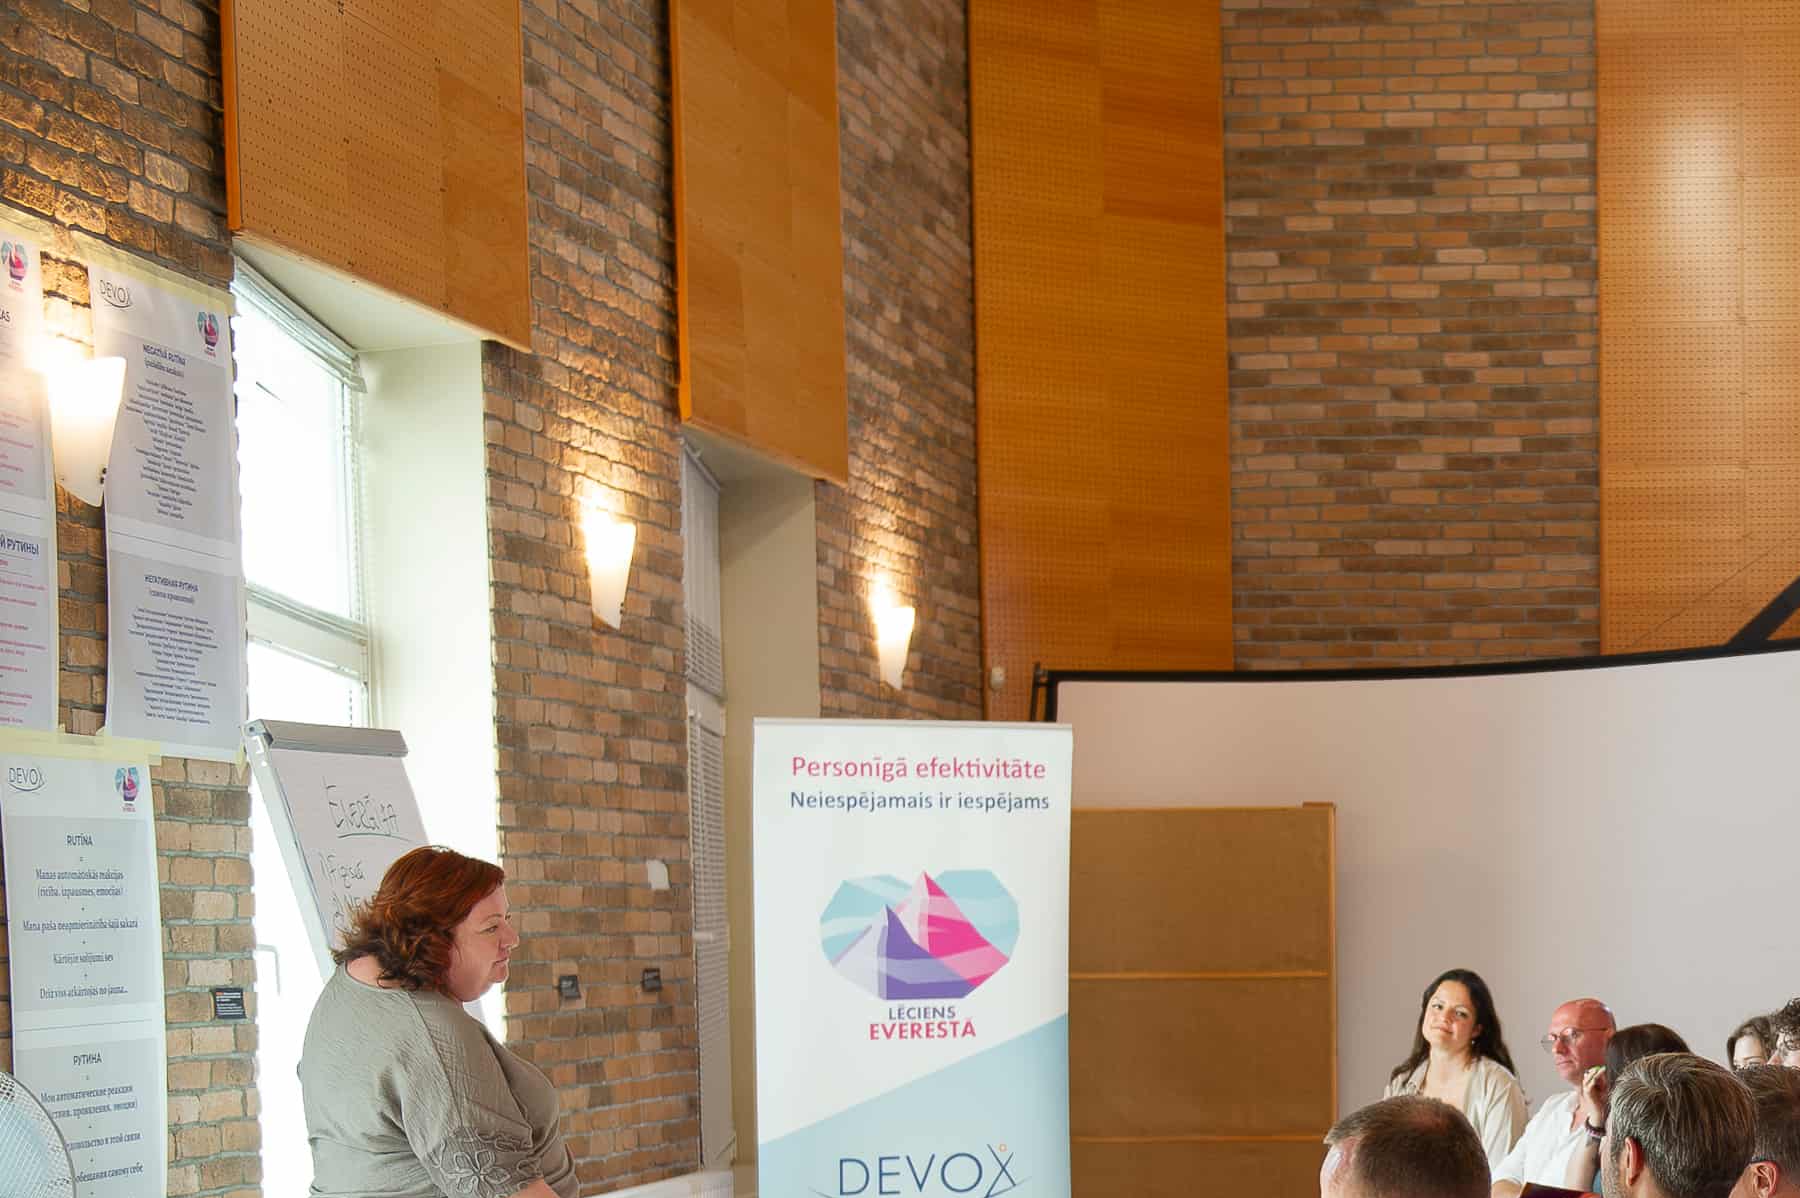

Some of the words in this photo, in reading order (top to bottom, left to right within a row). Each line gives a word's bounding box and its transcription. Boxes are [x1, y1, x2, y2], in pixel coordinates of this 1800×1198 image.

[7, 538, 40, 555] РУТИНЫ
[792, 756, 907, 782] Personīgā
[916, 757, 1046, 779] efektivitāte
[790, 791, 933, 812] Neiespējamais
[939, 792, 951, 809] ir
[958, 793, 1049, 813] iespējams
[66, 833, 93, 847] RUTĪNA
[869, 1018, 977, 1040] EVERESTĀ
[73, 1052, 103, 1066] РУТИНА
[838, 1143, 1017, 1198] DEVOX
